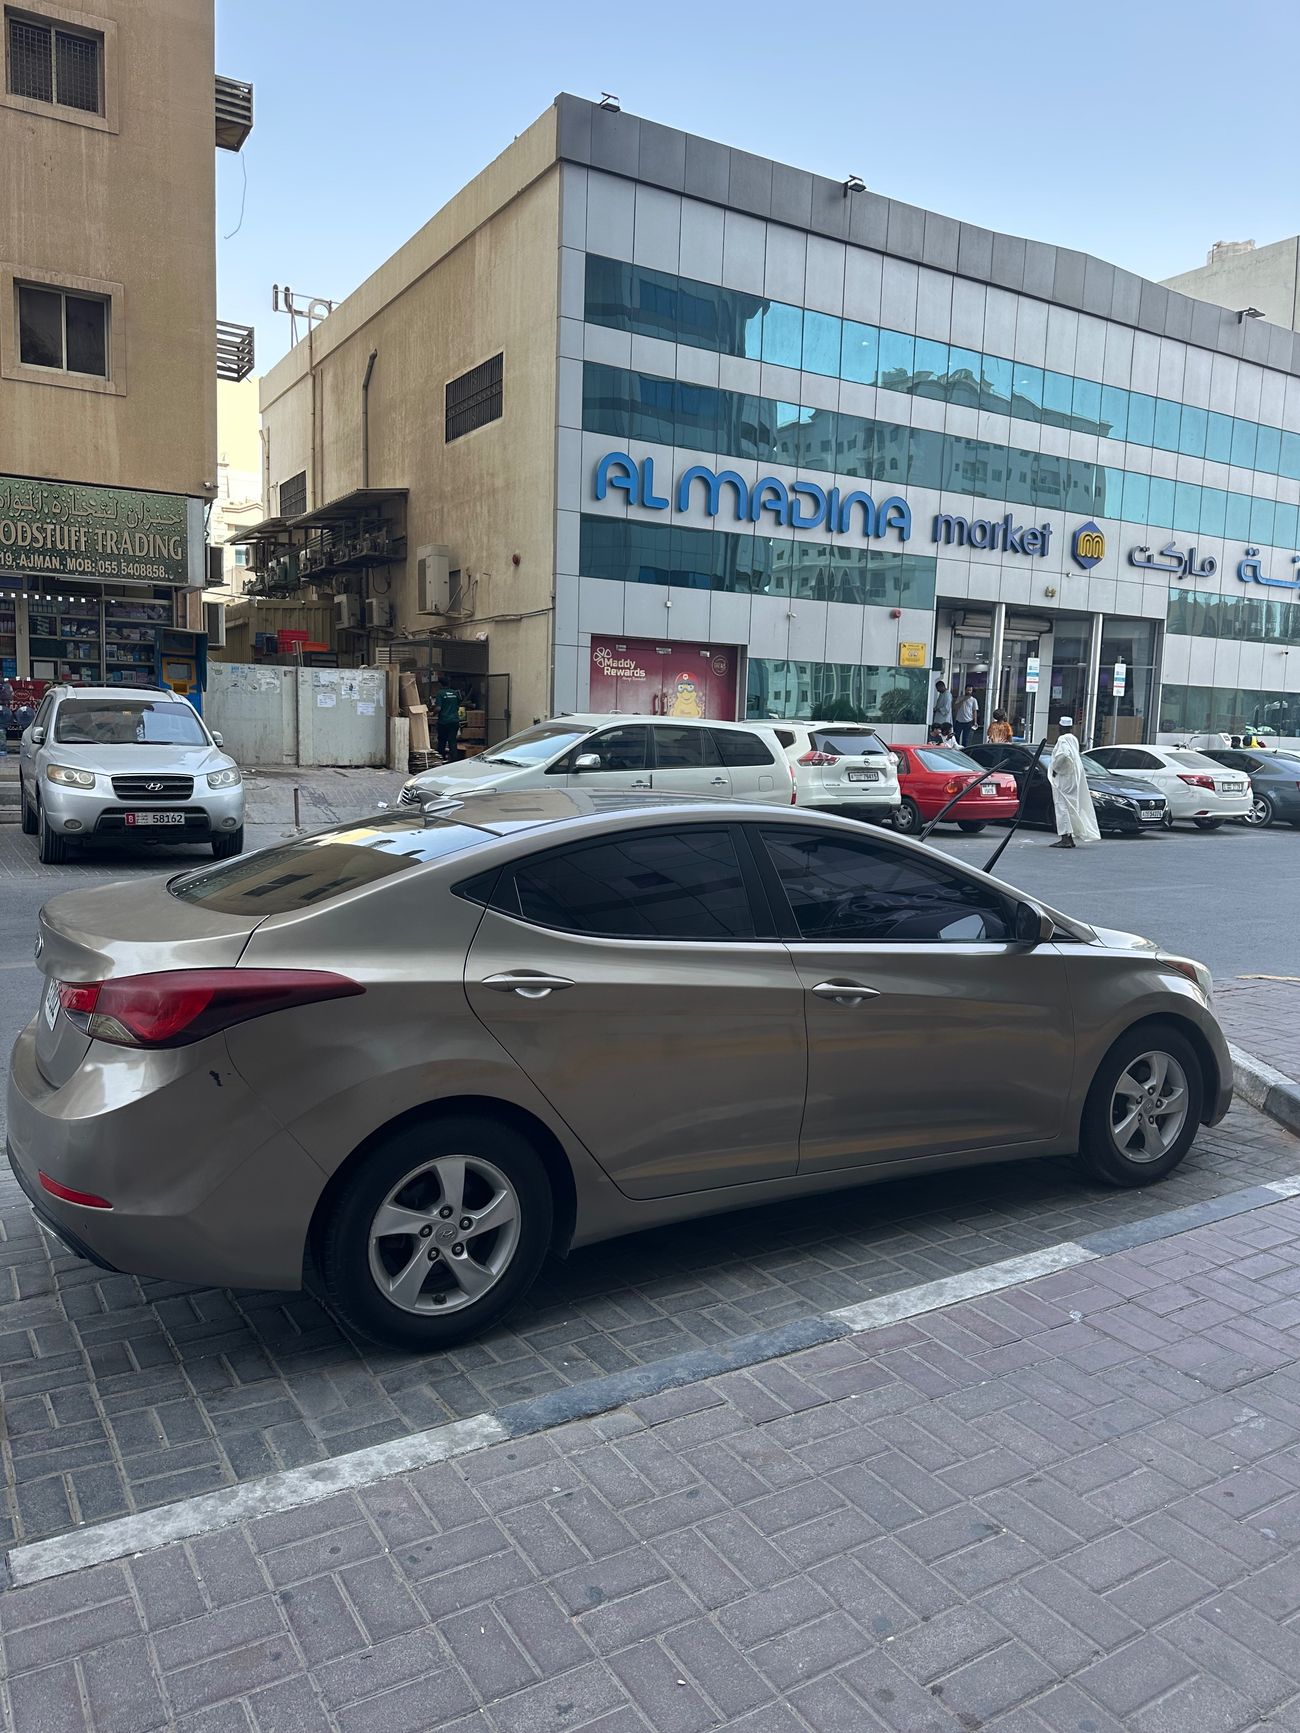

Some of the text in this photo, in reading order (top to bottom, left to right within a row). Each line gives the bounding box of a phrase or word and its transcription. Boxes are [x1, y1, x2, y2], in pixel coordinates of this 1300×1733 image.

[596, 451, 912, 541] AL MADINA
[95, 528, 182, 560] TRADING
[933, 512, 1053, 558] market
[99, 560, 118, 574] 055
[1128, 541, 1217, 580] ماركت
[604, 658, 636, 669] Maddy
[604, 667, 646, 677] Rewards
[152, 814, 183, 823] 58162
